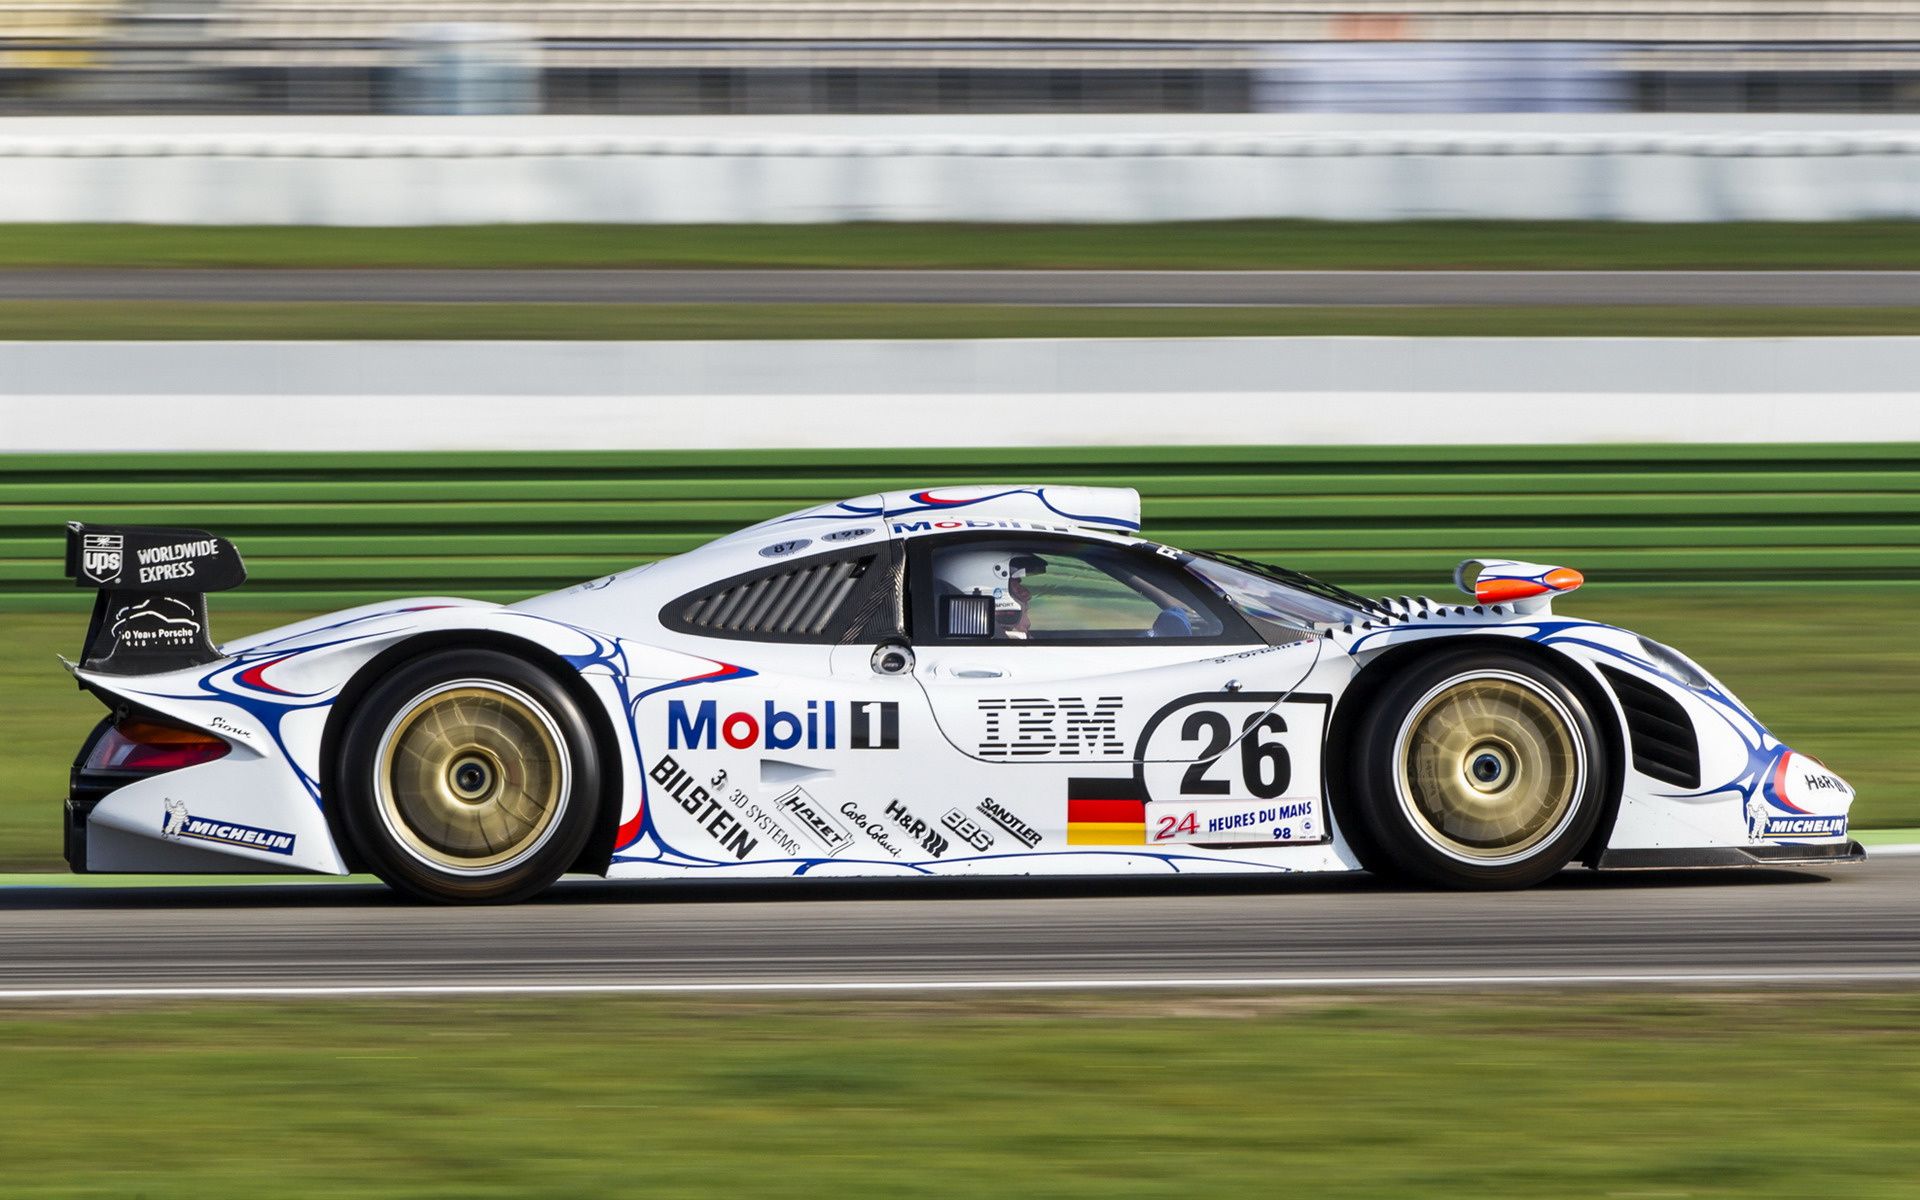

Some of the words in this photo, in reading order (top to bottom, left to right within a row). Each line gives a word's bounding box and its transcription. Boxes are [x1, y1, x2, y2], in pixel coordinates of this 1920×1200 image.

[892, 520, 1022, 534] Mobil
[137, 538, 219, 565] WORLDWIDE
[773, 541, 796, 554] 87
[85, 551, 121, 575] ups
[139, 561, 195, 584] EXPRESS
[158, 628, 193, 638] Porsche
[668, 700, 836, 750] Mobil
[978, 696, 1124, 756] IBM
[1180, 710, 1292, 799] 26
[1804, 775, 1833, 791] H&R
[649, 754, 758, 860] BILSTEIN
[786, 796, 845, 845] HAZET
[840, 802, 867, 828] Carlo
[885, 799, 927, 840] H&R
[981, 797, 1043, 846] SANDTLER
[1153, 811, 1200, 842] 24
[1209, 811, 1256, 833] HEURES
[1259, 807, 1276, 824] DU
[1279, 801, 1312, 821] MANS
[188, 820, 292, 849] MICHELIN
[729, 789, 746, 809] 3D
[746, 804, 801, 857] SYSTEMS
[941, 807, 994, 852] BBS
[1273, 827, 1292, 840] 98
[1770, 818, 1845, 836] MICHELIN
